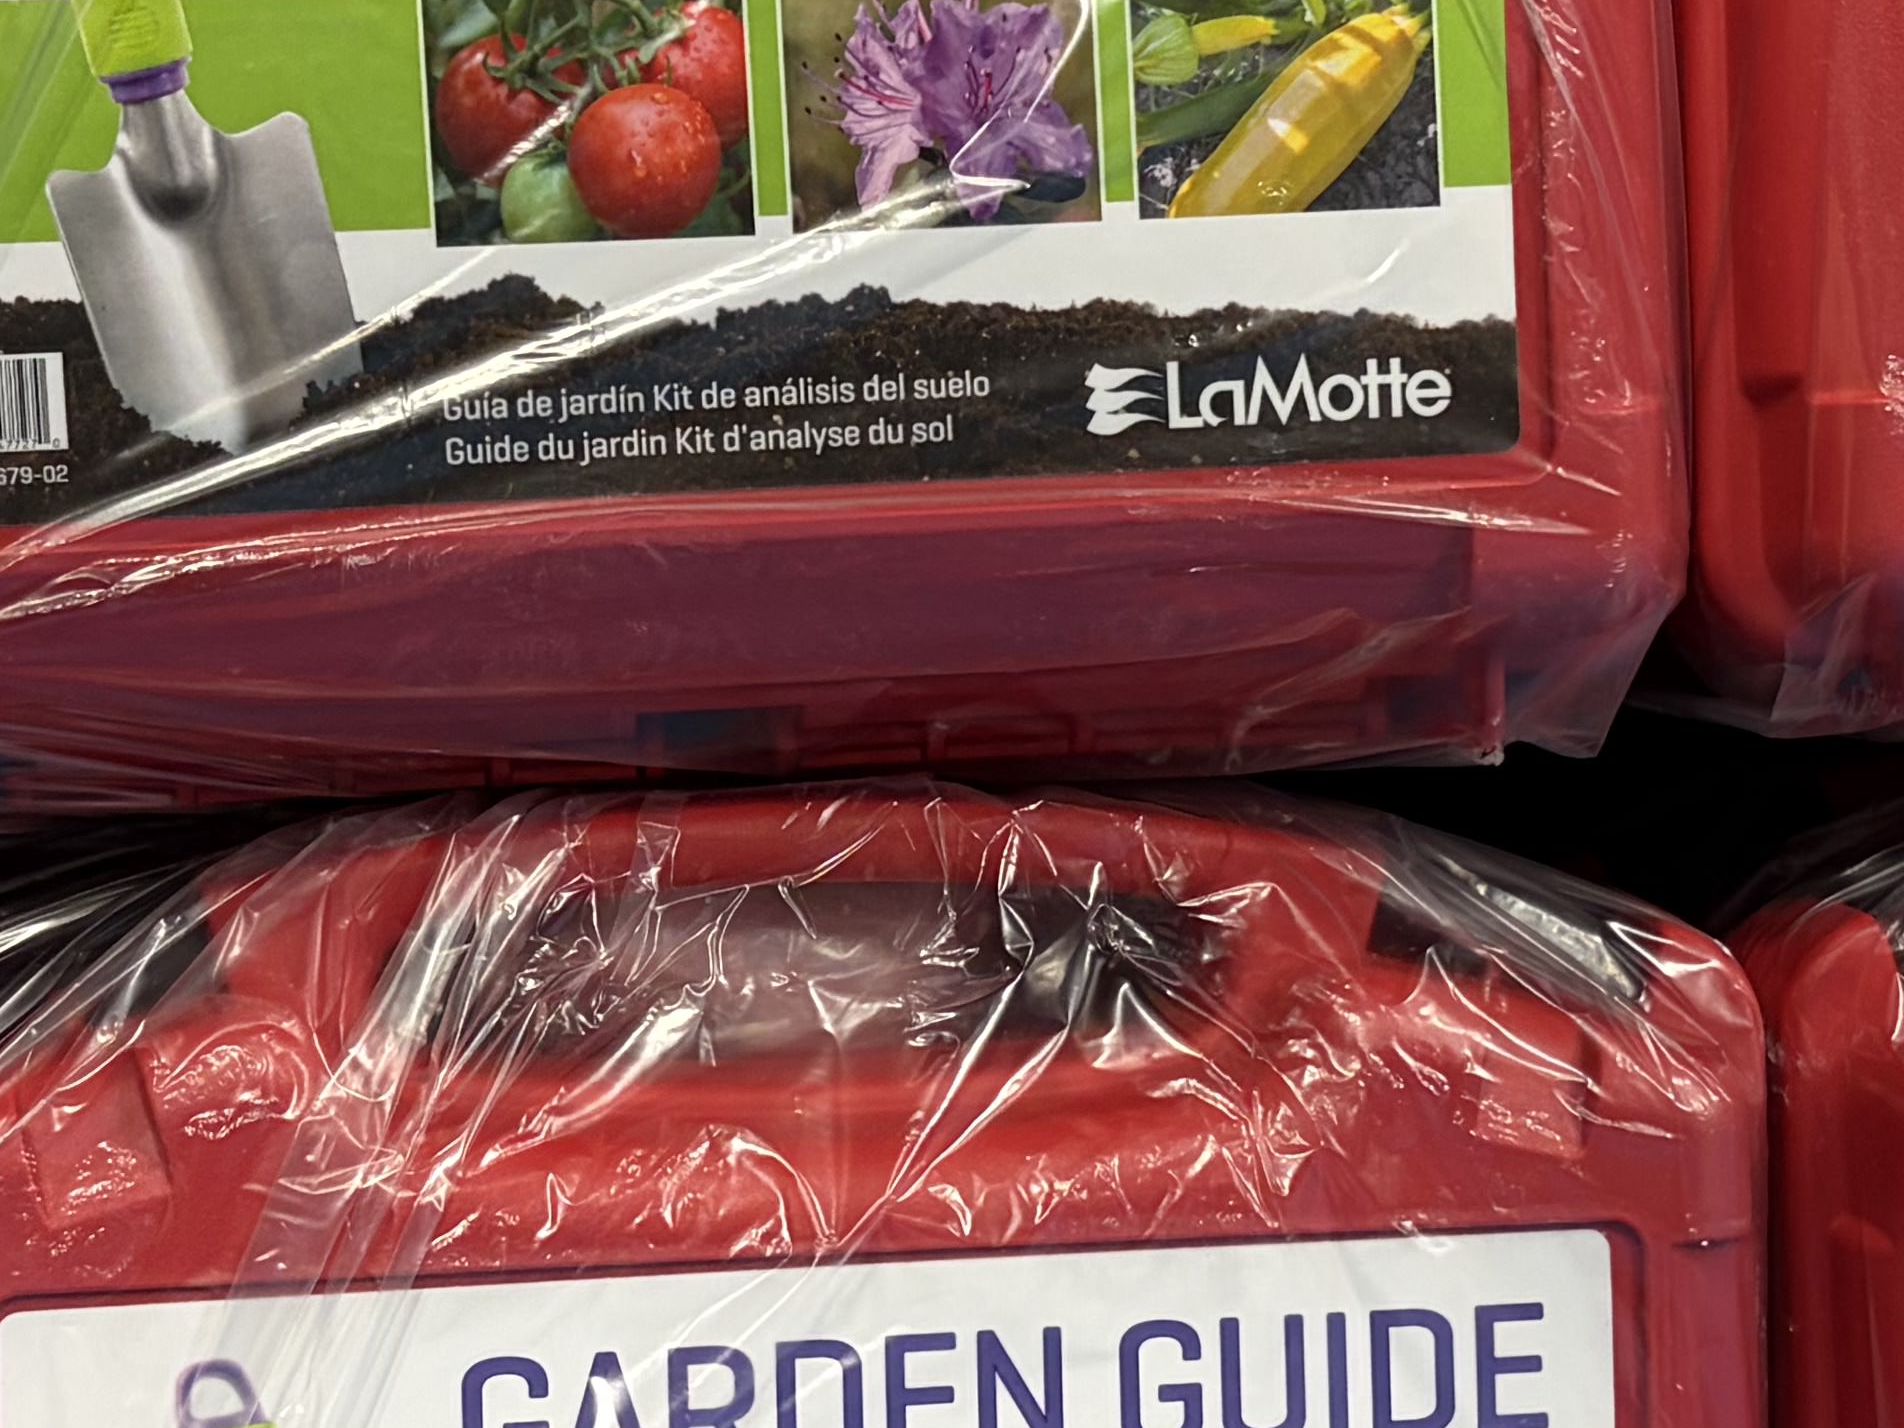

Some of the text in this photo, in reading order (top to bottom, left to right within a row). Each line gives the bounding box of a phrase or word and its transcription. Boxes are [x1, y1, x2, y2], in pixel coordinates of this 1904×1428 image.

[442, 368, 991, 424] Guía de jardín Kit de análisis del suelo
[1166, 353, 1452, 429] LaMotte
[445, 413, 954, 467] Guide du jardin Kit d'analyse du sol
